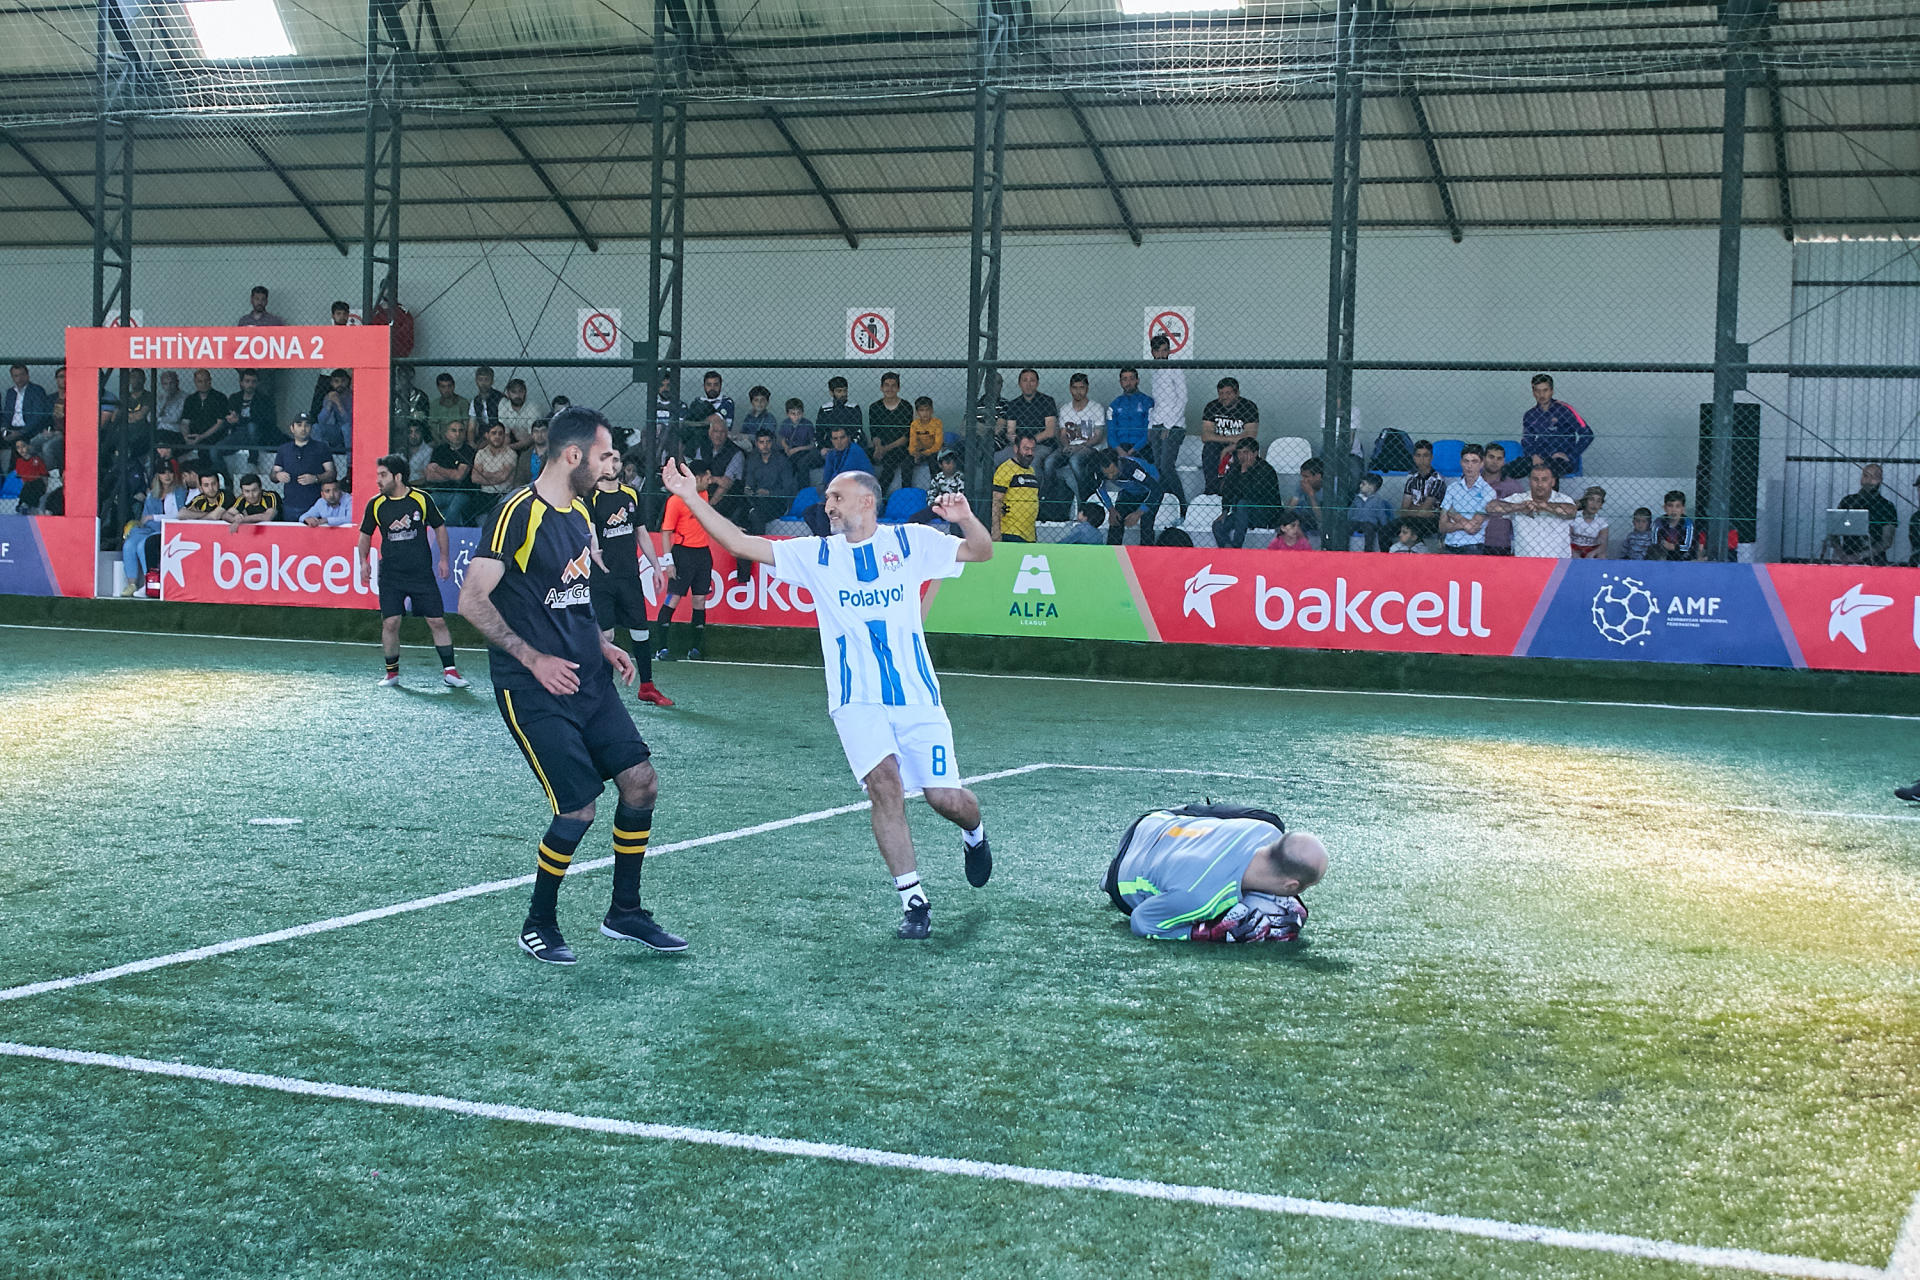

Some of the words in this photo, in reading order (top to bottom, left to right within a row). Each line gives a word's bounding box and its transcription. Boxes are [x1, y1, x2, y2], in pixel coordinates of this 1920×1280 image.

[129, 333, 228, 360] EHTİYAT
[233, 335, 305, 360] ZONA
[309, 335, 324, 360] 2
[212, 541, 380, 596] bakcell
[1009, 601, 1059, 618] ALFA
[1254, 574, 1491, 638] bakcell
[1667, 596, 1721, 616] AMF
[931, 744, 947, 777] 8
